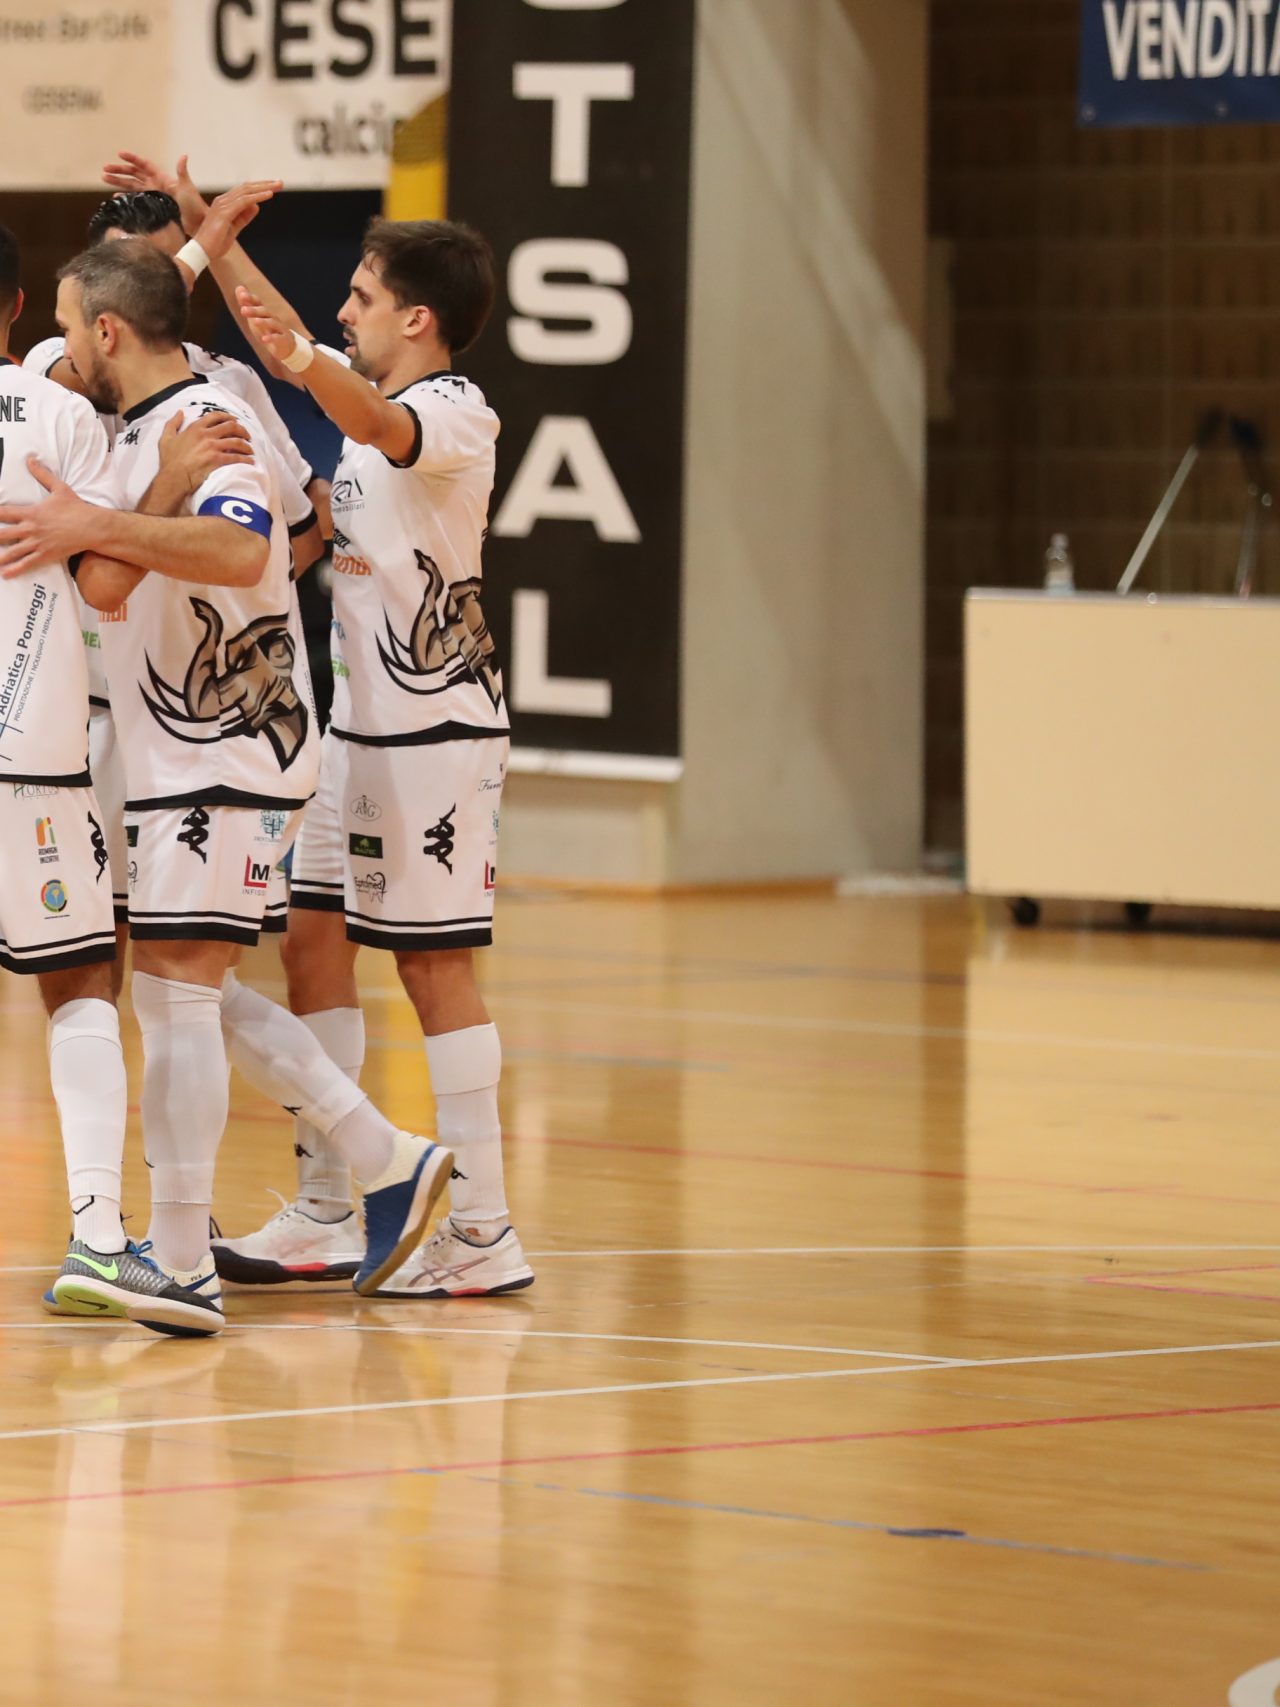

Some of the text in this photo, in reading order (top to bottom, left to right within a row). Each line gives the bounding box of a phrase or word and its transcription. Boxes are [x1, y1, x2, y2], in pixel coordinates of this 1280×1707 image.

[296, 102, 410, 154] calci
[493, 0, 640, 716] TSAL
[221, 500, 254, 524] C
[17, 583, 48, 649] Ponteggi
